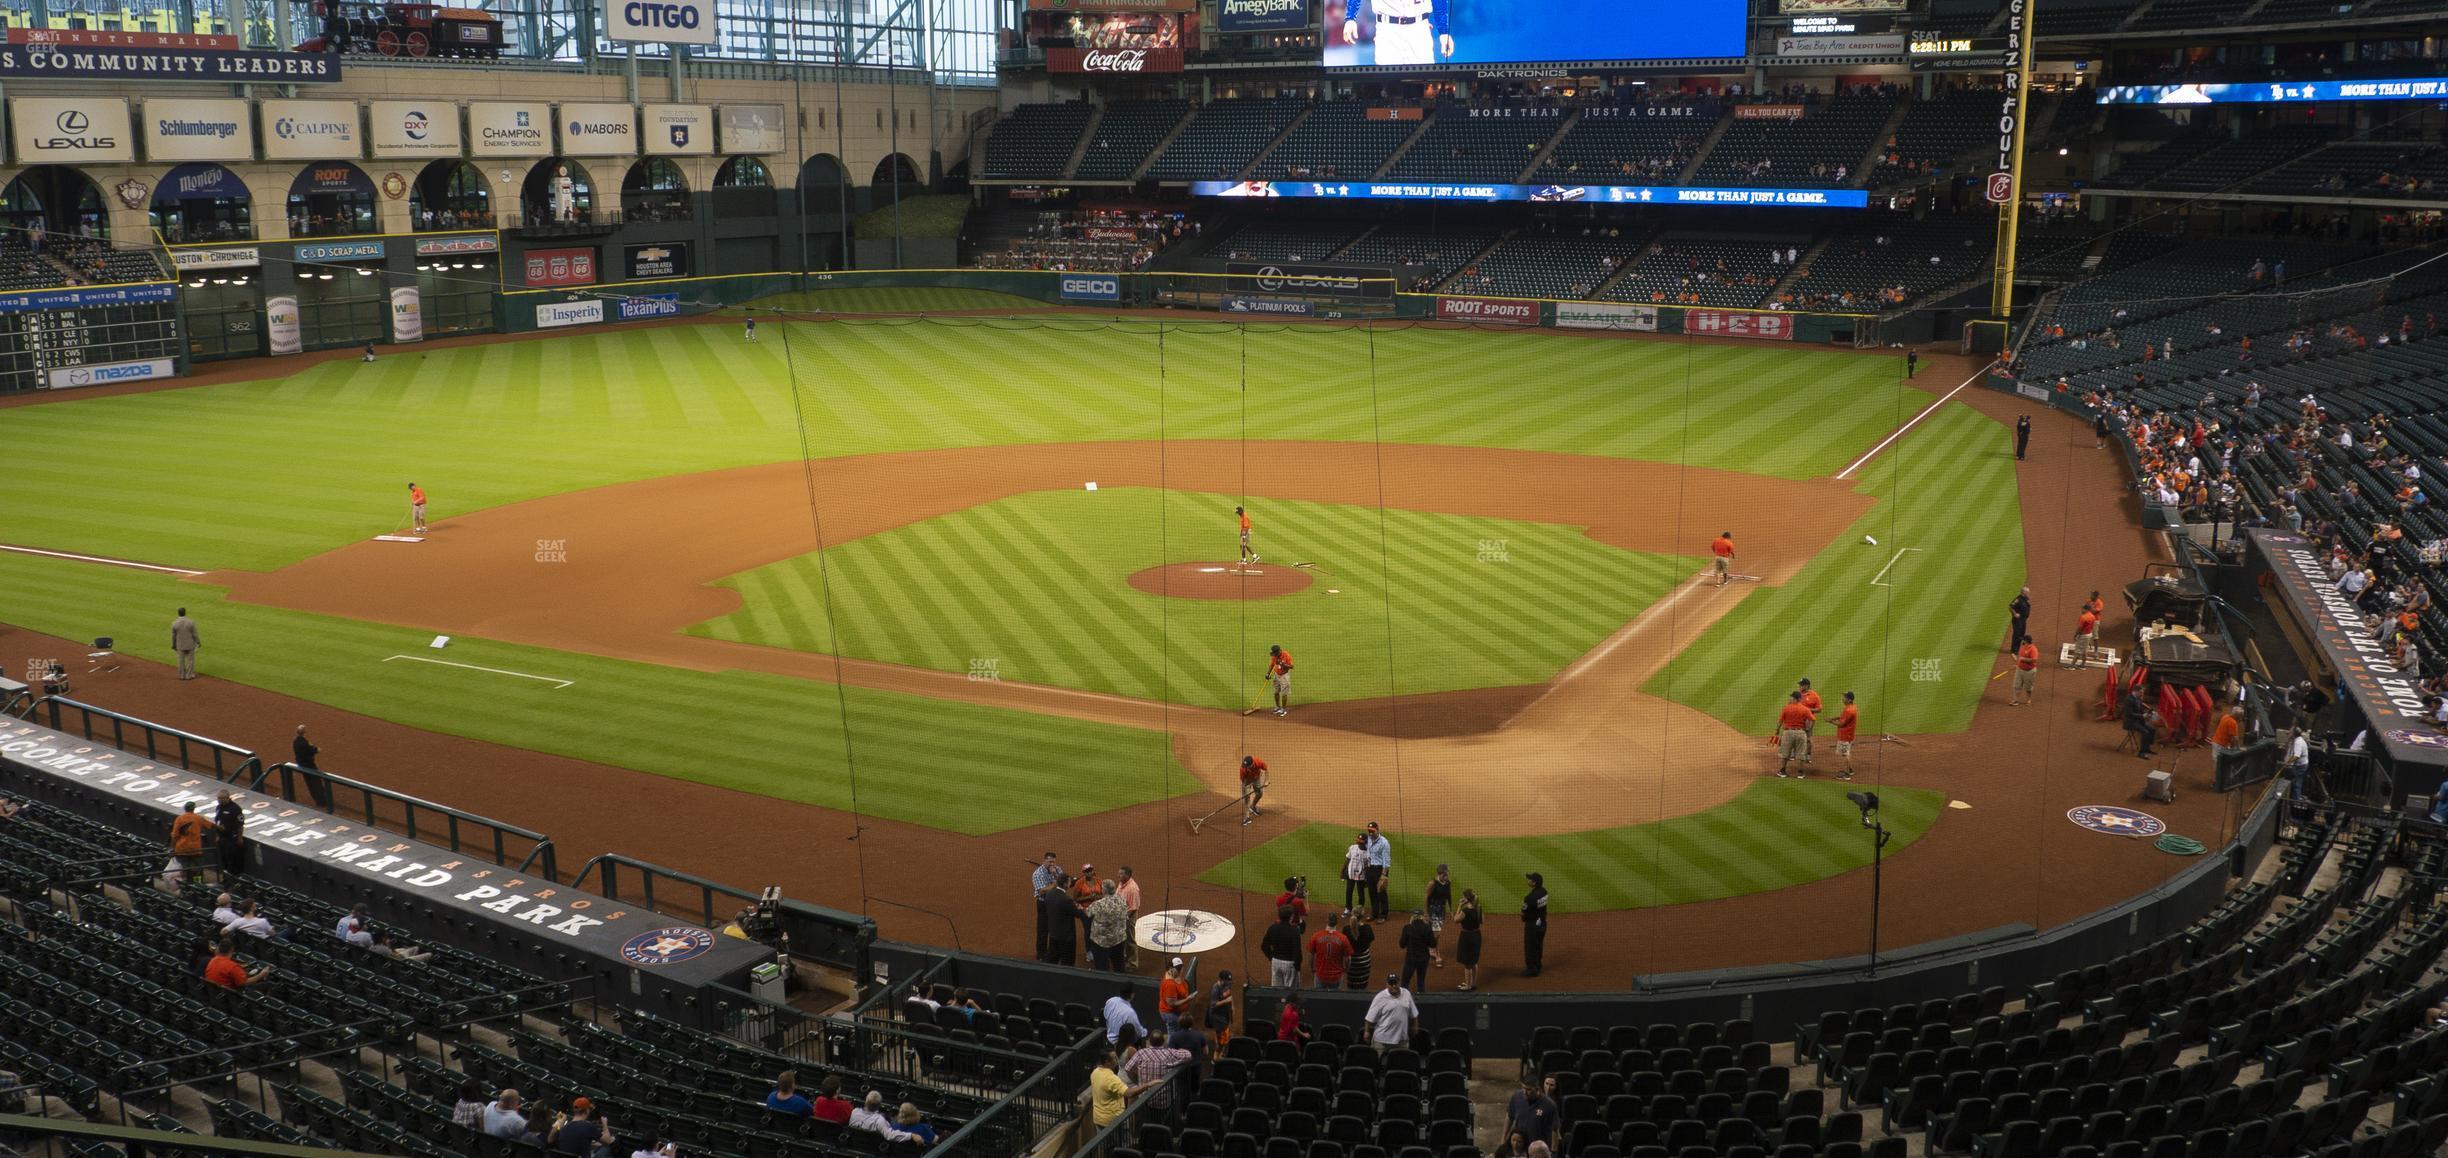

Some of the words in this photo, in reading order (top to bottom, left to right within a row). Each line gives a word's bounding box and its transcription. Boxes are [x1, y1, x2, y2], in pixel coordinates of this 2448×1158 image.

[625, 1, 700, 29] CITGO
[1793, 18, 1827, 26] WELCOME
[159, 36, 217, 46] MAID
[1910, 41, 1949, 53] 6:28:11
[1951, 40, 1971, 51] PM
[30, 53, 205, 72] COMMUNITY
[219, 58, 328, 75] LEADERS
[1083, 50, 1147, 72] Coca-Cola
[1478, 70, 1567, 78] DAKTRONICS
[2340, 84, 2377, 96] MORE
[2378, 83, 2411, 95] THAN
[2411, 82, 2437, 97] JUST
[2437, 82, 2446, 94] A
[1469, 108, 1512, 117] MORE
[1520, 108, 1560, 117] THAN
[1585, 107, 1619, 117] JUST
[1629, 108, 1637, 116] A
[1647, 107, 1700, 116] GAME.
[1744, 106, 1757, 116] ALL
[1758, 106, 1771, 116] YOU
[1772, 106, 1787, 116] CAN
[160, 119, 237, 139] Schlumberger
[297, 123, 350, 135] CALPINE
[404, 121, 428, 130] OXY
[584, 123, 628, 135] NABORS
[483, 127, 541, 138] CHAMPION
[34, 137, 116, 149] LEXUS
[315, 169, 350, 182] ROOT
[1370, 186, 1403, 196] MORE
[1404, 186, 1430, 196] THAN
[1431, 186, 1453, 198] JUST
[1453, 187, 1461, 196] A
[1678, 190, 1715, 201] MORE
[1717, 191, 1748, 202] THAN
[1749, 192, 1776, 204] JUST
[1776, 193, 1785, 202] A
[1088, 229, 1133, 240] Budweiser
[211, 250, 254, 262] CHRONICLE
[301, 249, 308, 258] C
[318, 248, 326, 257] D
[329, 248, 353, 257] SCRAP
[355, 246, 380, 255] METAL
[530, 267, 543, 277] 66
[553, 265, 565, 275] 66
[576, 264, 587, 274] 66
[636, 262, 659, 270] HOUSTON
[1063, 280, 1117, 294] GEICO
[38, 296, 70, 304] UNITED
[553, 306, 601, 321] Insperity
[620, 298, 676, 317] TexanPlus
[1250, 302, 1282, 312] PLATINUM
[1283, 303, 1306, 313] POOLS
[1445, 300, 1483, 314] ROOT
[1484, 304, 1530, 317] SPORTS
[61, 311, 75, 319] MIN
[61, 320, 76, 328] BAL
[230, 321, 251, 332] 362
[63, 330, 77, 338] CLE
[65, 357, 81, 366] LAA
[95, 364, 153, 381] mazda
[2376, 677, 2430, 717] HOME
[100, 771, 161, 792] TO
[319, 841, 453, 888] MAID
[454, 885, 604, 936] PARK
[440, 860, 628, 921] ASTROS
[662, 928, 711, 946] HOUSTON
[625, 947, 669, 963] ASTROS
